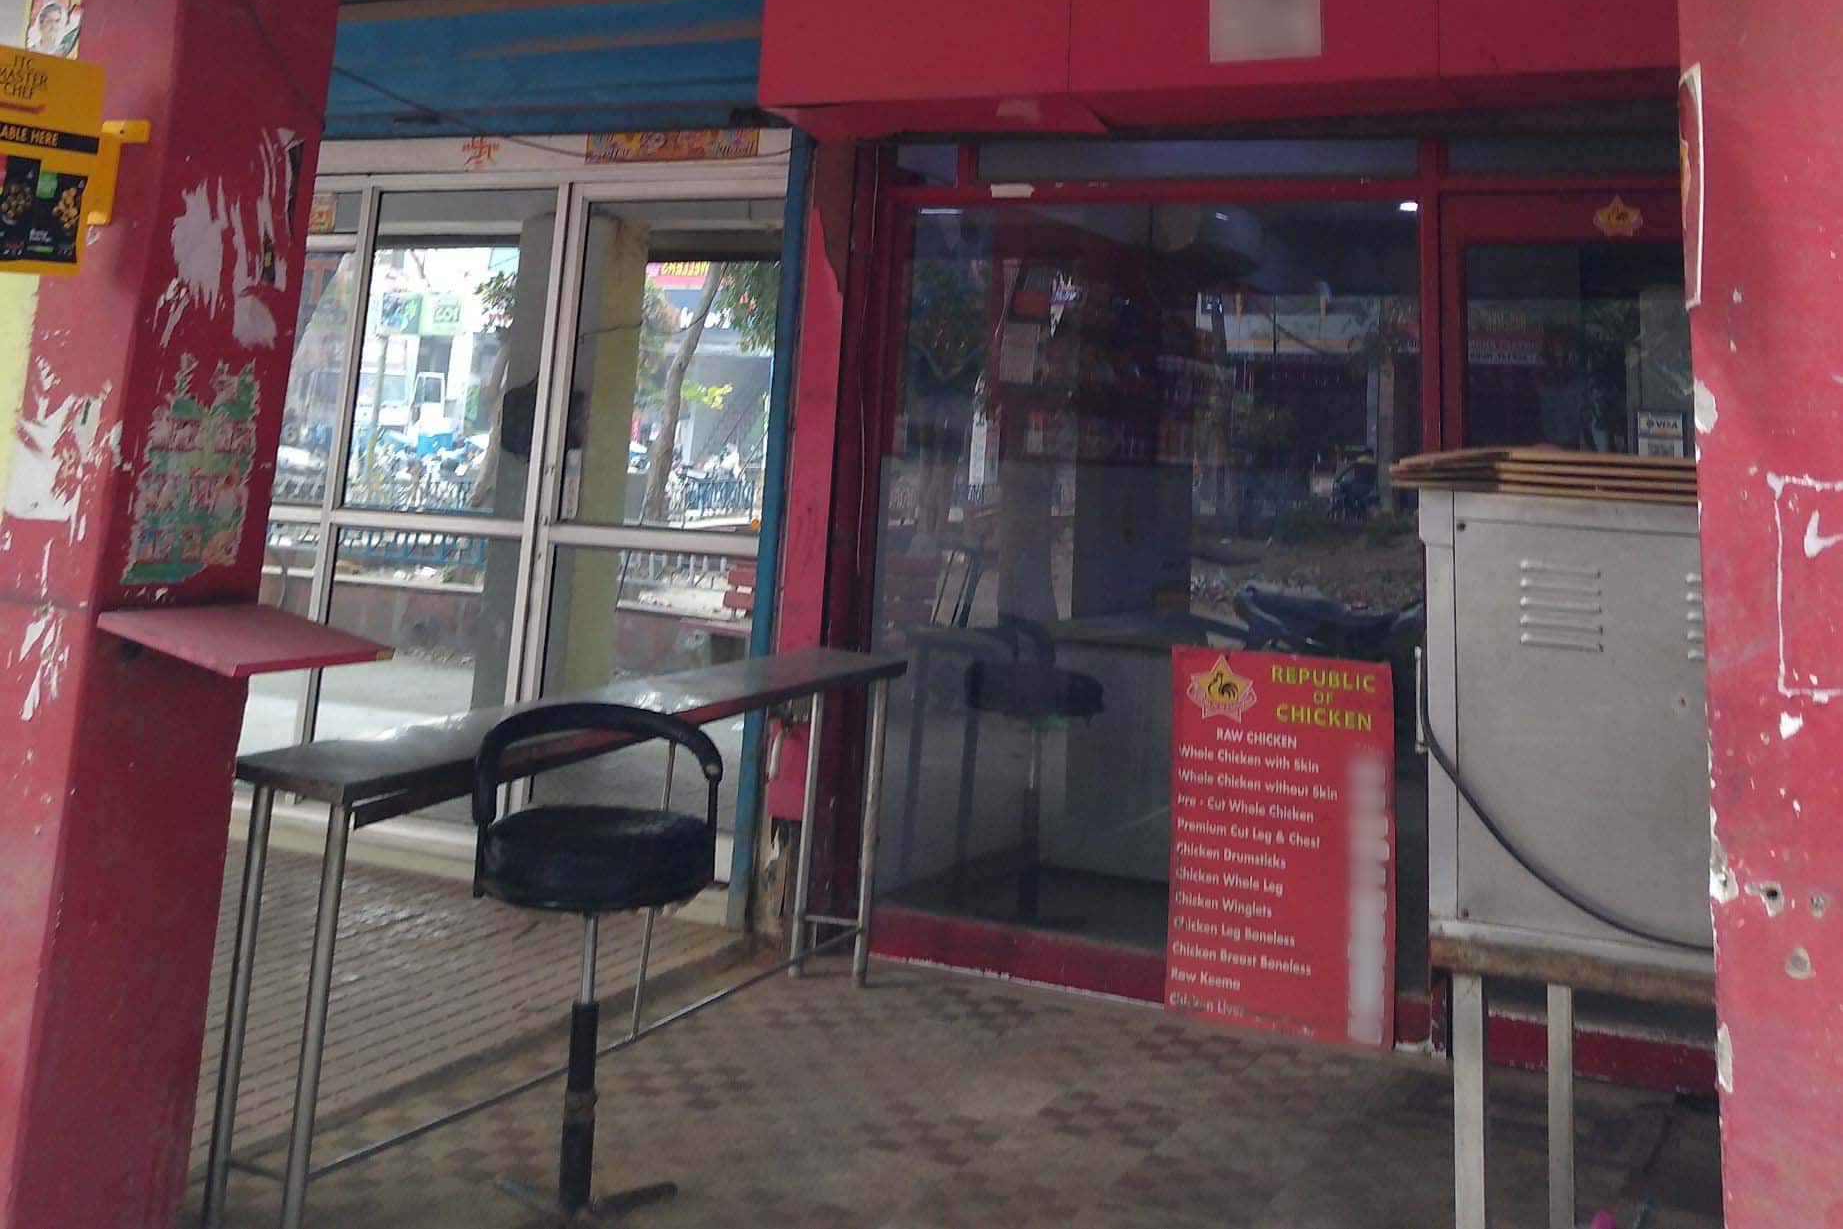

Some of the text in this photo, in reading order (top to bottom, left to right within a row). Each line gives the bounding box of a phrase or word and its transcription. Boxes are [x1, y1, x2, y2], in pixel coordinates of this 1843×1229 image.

[30, 129, 59, 147] HERE
[1271, 664, 1377, 693] REPUBLIC
[1313, 689, 1333, 705] OF
[1276, 704, 1372, 731] CHICKEN
[1216, 727, 1297, 750] RAW CHICKEN
[1179, 744, 1319, 774] Whole Chicken with Skin
[1178, 768, 1338, 801] Whole Chicken without Skin
[1207, 796, 1225, 811] Cut
[1229, 798, 1265, 817] Whole
[1269, 804, 1314, 823] Chicken
[1177, 817, 1227, 837] Premium
[1230, 823, 1249, 839] Cut
[1252, 827, 1272, 845] Leg
[1288, 832, 1321, 849] Chest
[1176, 841, 1286, 869] Chicken Drumsticks
[1176, 867, 1284, 897] Chicken Whole Leg
[1175, 891, 1272, 918] Chicken Winglets
[1221, 922, 1241, 941] Leg
[1244, 926, 1295, 948] Boneless
[1172, 941, 1312, 976] Chicken Breast Boneless
[1170, 967, 1240, 991] Raw Keema
